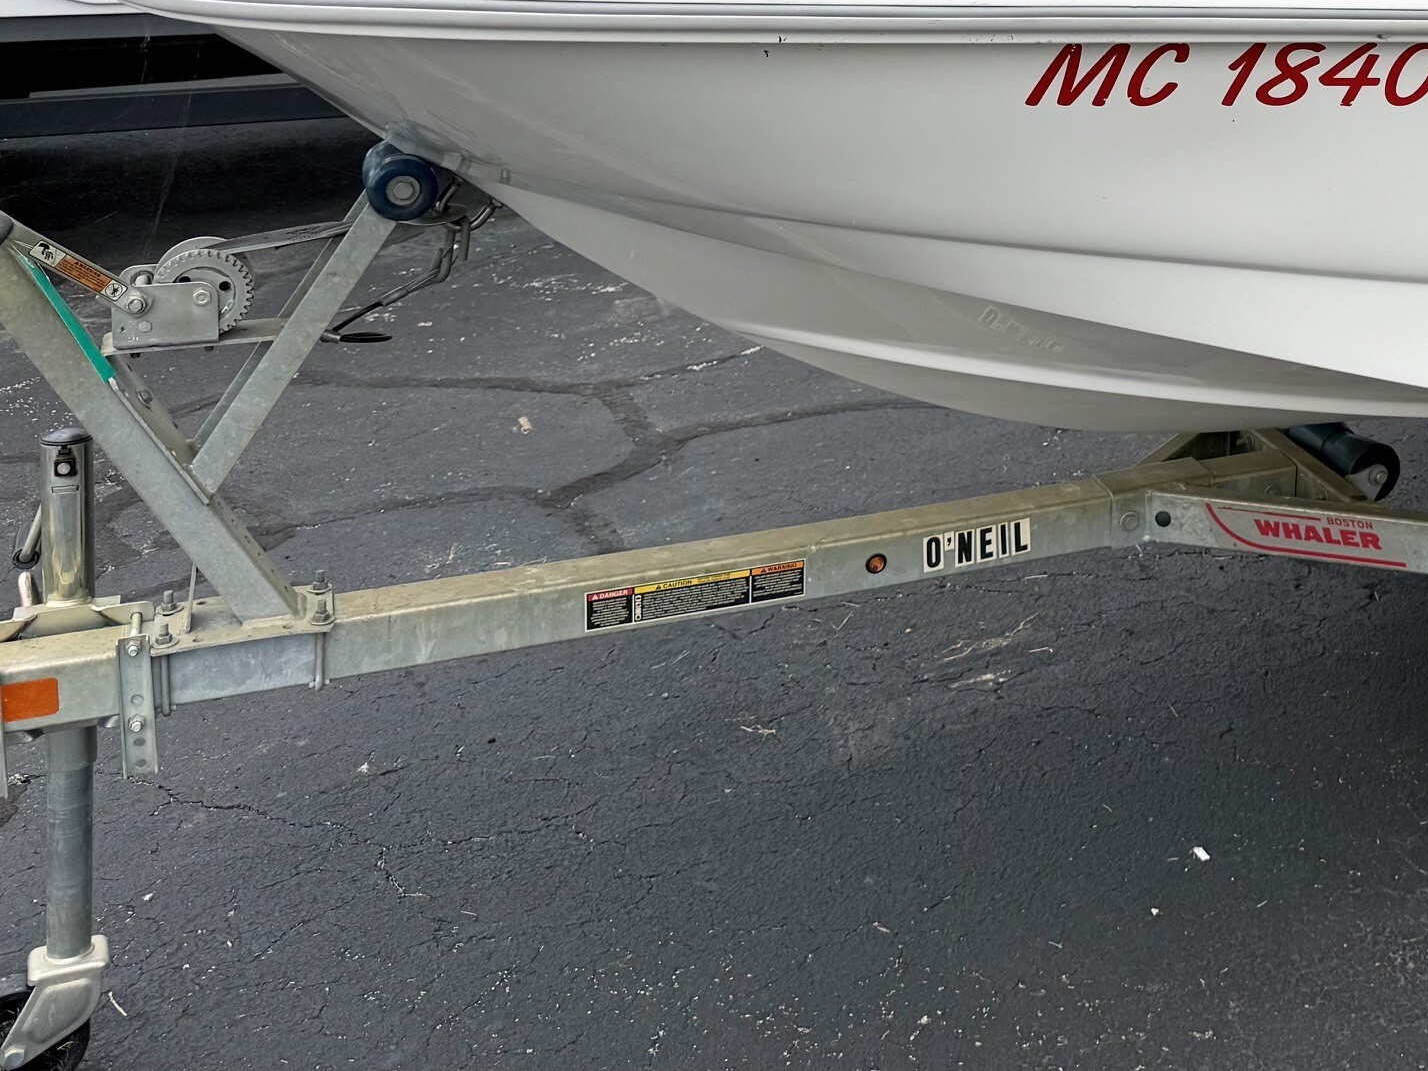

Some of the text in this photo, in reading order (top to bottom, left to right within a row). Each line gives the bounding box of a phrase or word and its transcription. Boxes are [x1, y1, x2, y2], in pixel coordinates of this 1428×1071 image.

[1025, 42, 1191, 108] MC
[1254, 518, 1383, 551] WHALER
[1326, 516, 1374, 530] BOSTON
[926, 521, 1029, 569] O'NEIL
[599, 589, 629, 599] DANGER
[662, 579, 693, 589] CAUTION
